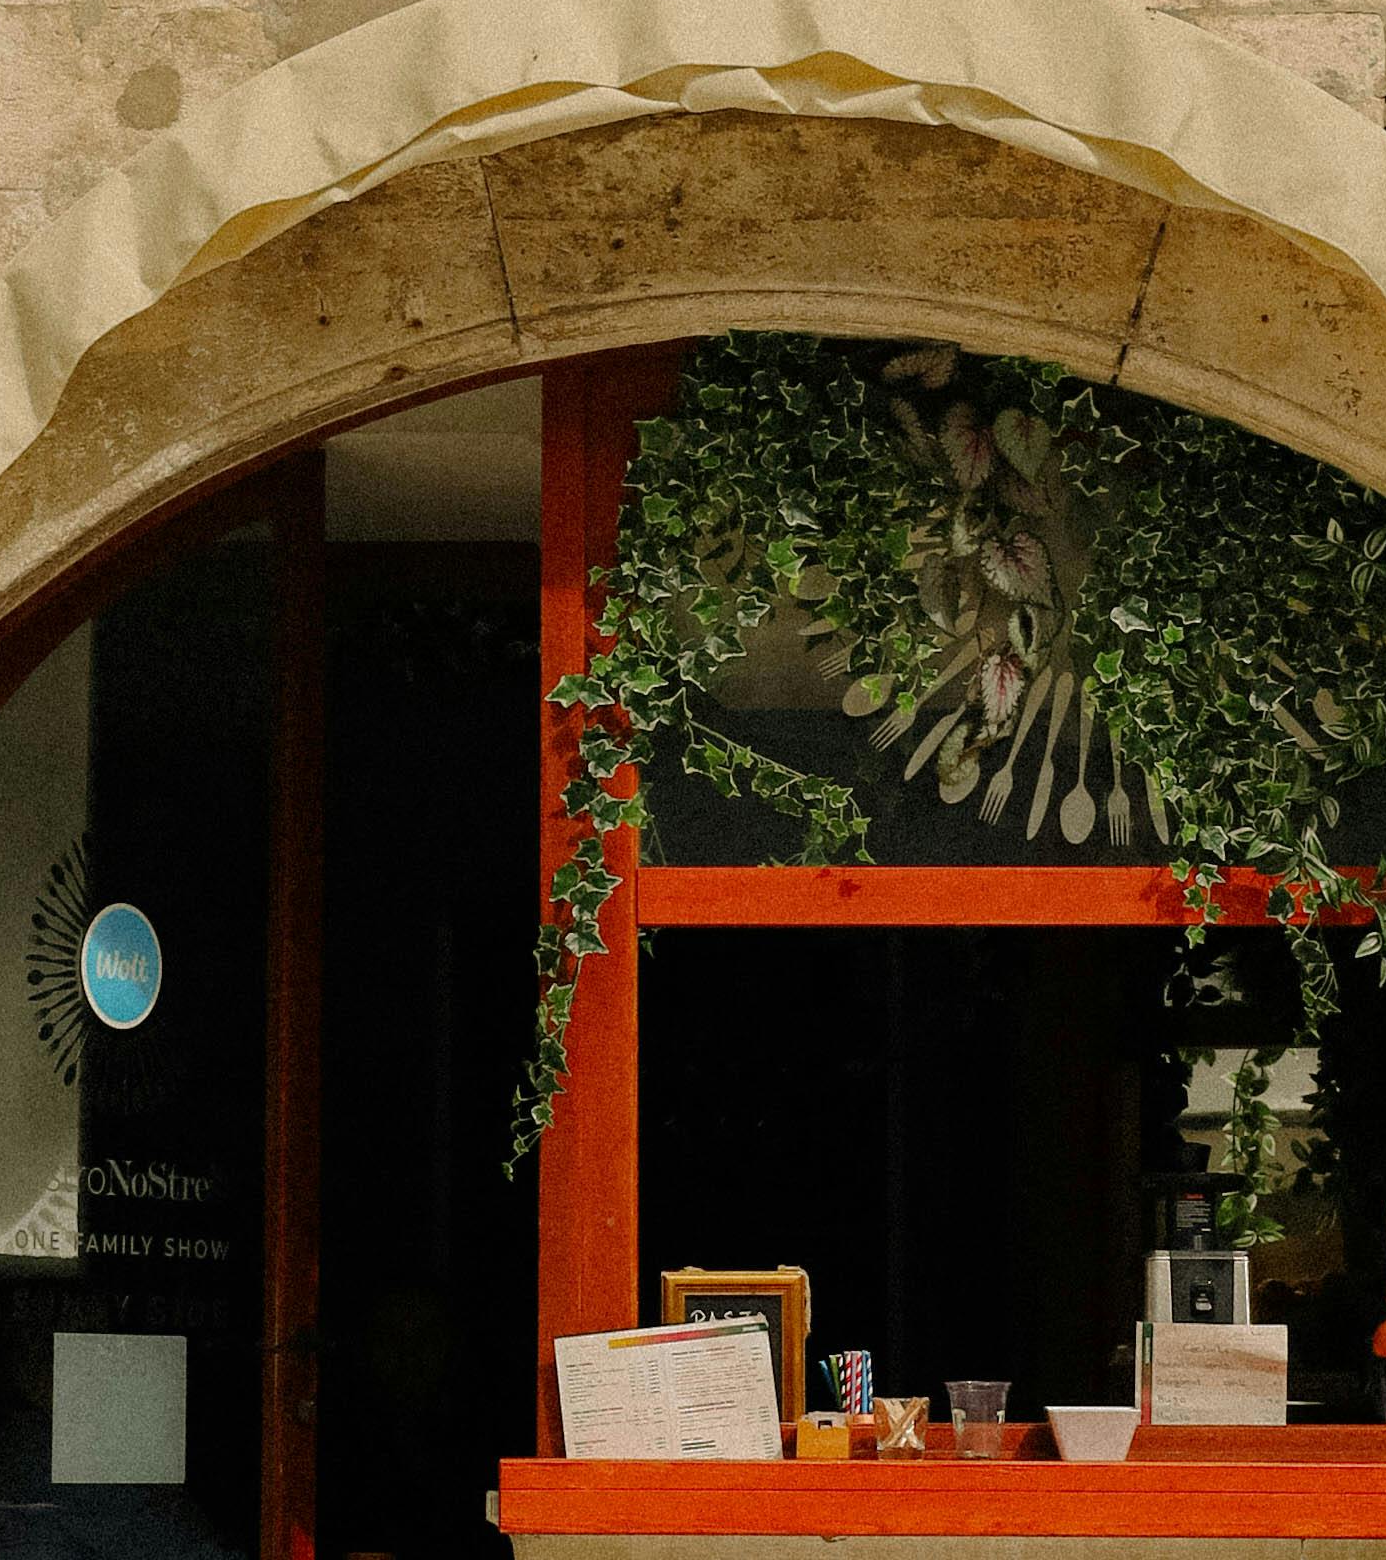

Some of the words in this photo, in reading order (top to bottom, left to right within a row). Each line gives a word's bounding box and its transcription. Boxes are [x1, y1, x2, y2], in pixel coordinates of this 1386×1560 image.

[95, 949, 151, 983] Wolt
[14, 1228, 61, 1251] ONE
[76, 1232, 155, 1257] FAMILY
[162, 1236, 231, 1262] SHOW
